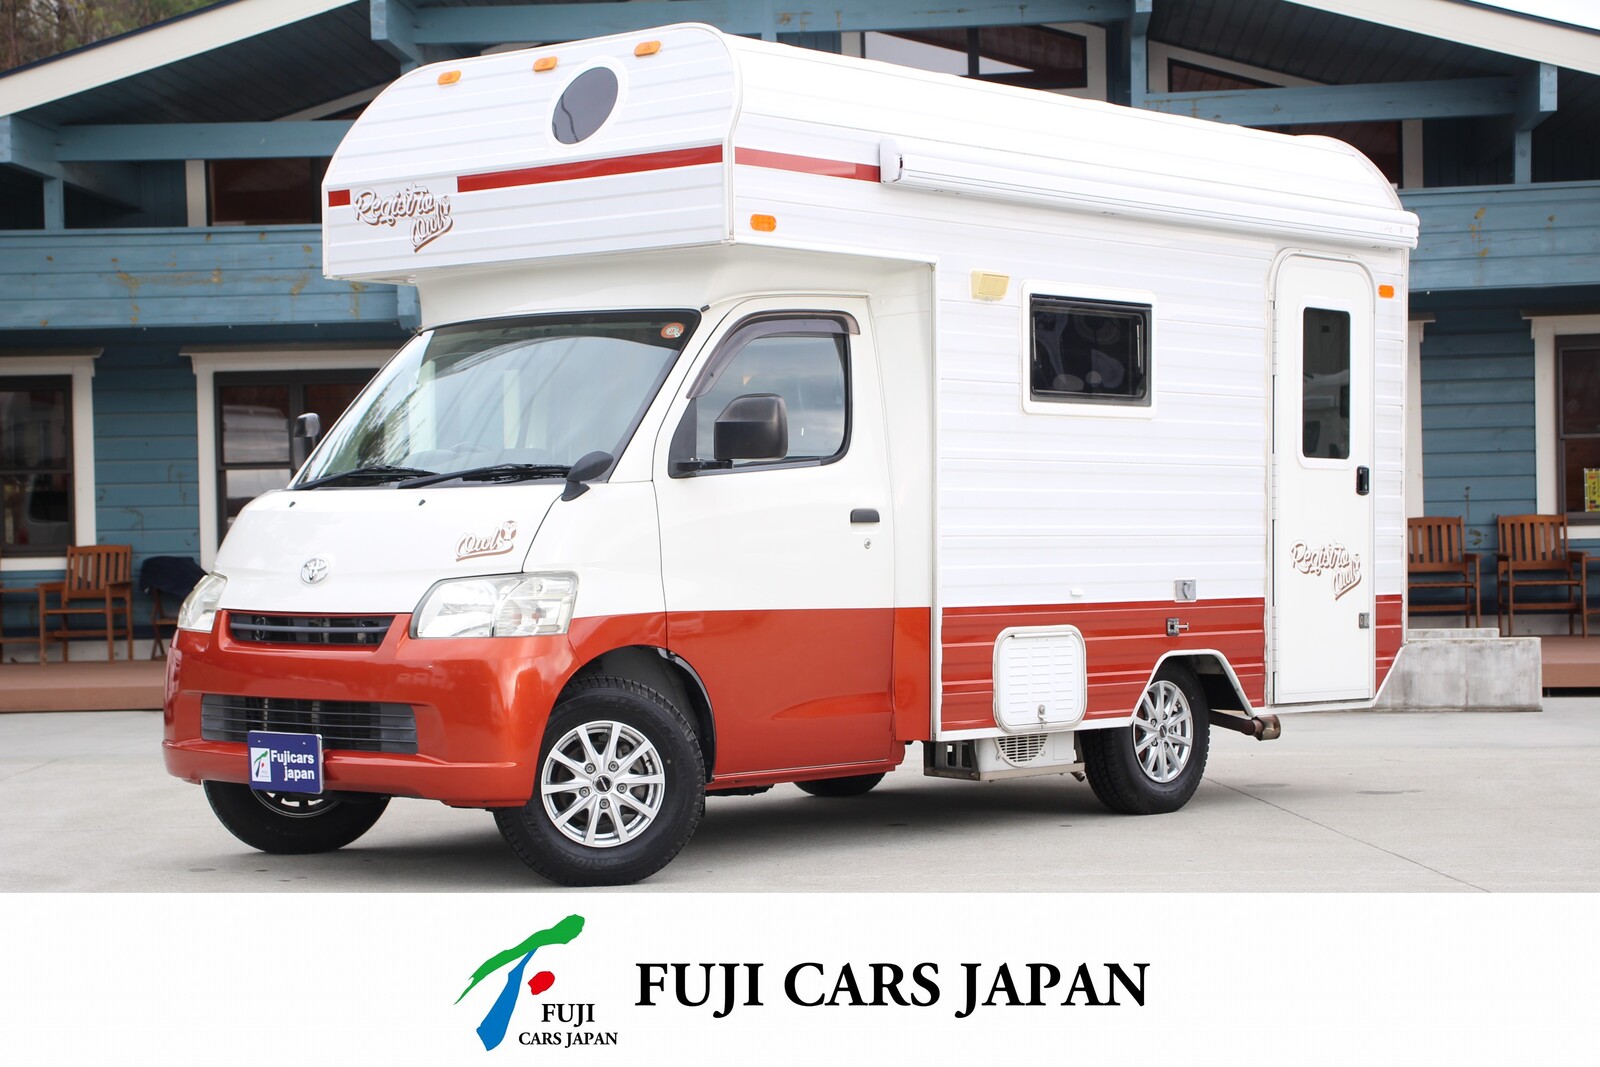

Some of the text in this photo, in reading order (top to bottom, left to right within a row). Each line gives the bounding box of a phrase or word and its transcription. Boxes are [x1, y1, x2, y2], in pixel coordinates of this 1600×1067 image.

[353, 182, 435, 227] Registro
[270, 749, 315, 766] Fujicars
[283, 765, 315, 782] japan
